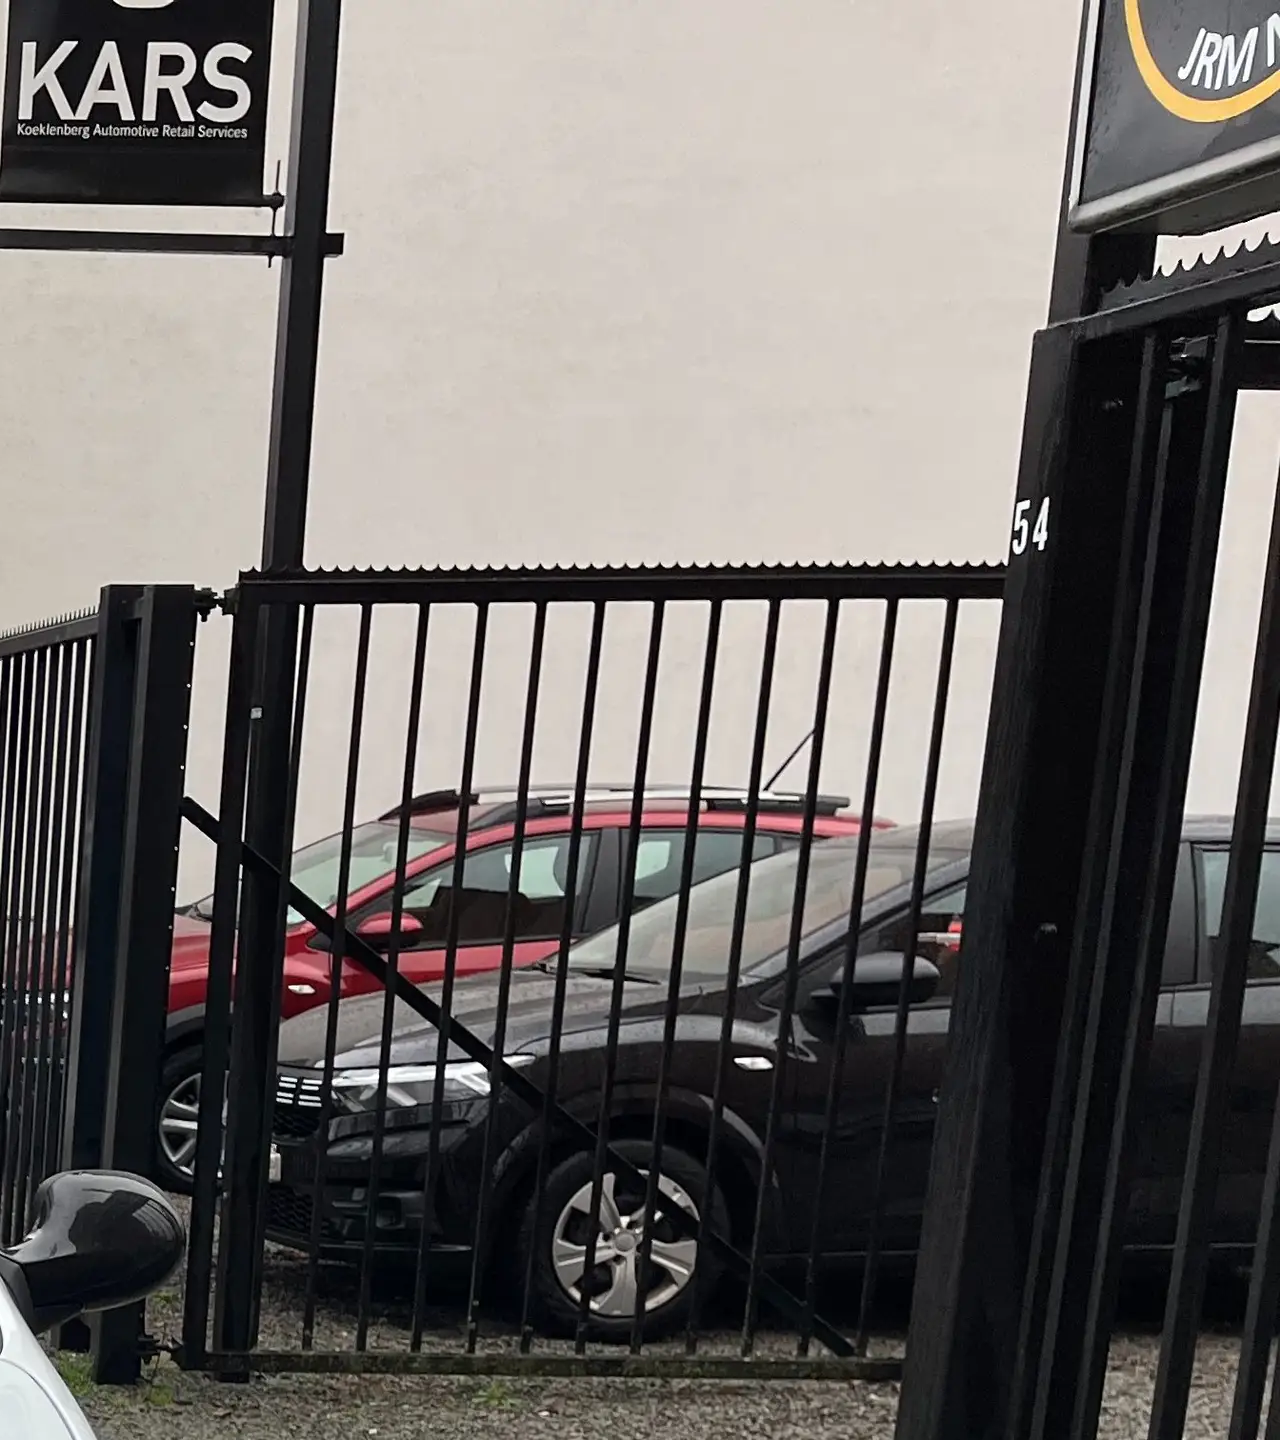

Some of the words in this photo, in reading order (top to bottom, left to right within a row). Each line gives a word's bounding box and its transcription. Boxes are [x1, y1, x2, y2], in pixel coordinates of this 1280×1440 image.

[17, 40, 253, 123] KARS
[1177, 27, 1259, 90] JRM
[17, 123, 90, 139] Koeklenberg
[93, 124, 159, 137] Automotive
[162, 125, 195, 137] Retail
[197, 125, 248, 138] Services
[1011, 497, 1050, 556] 54
